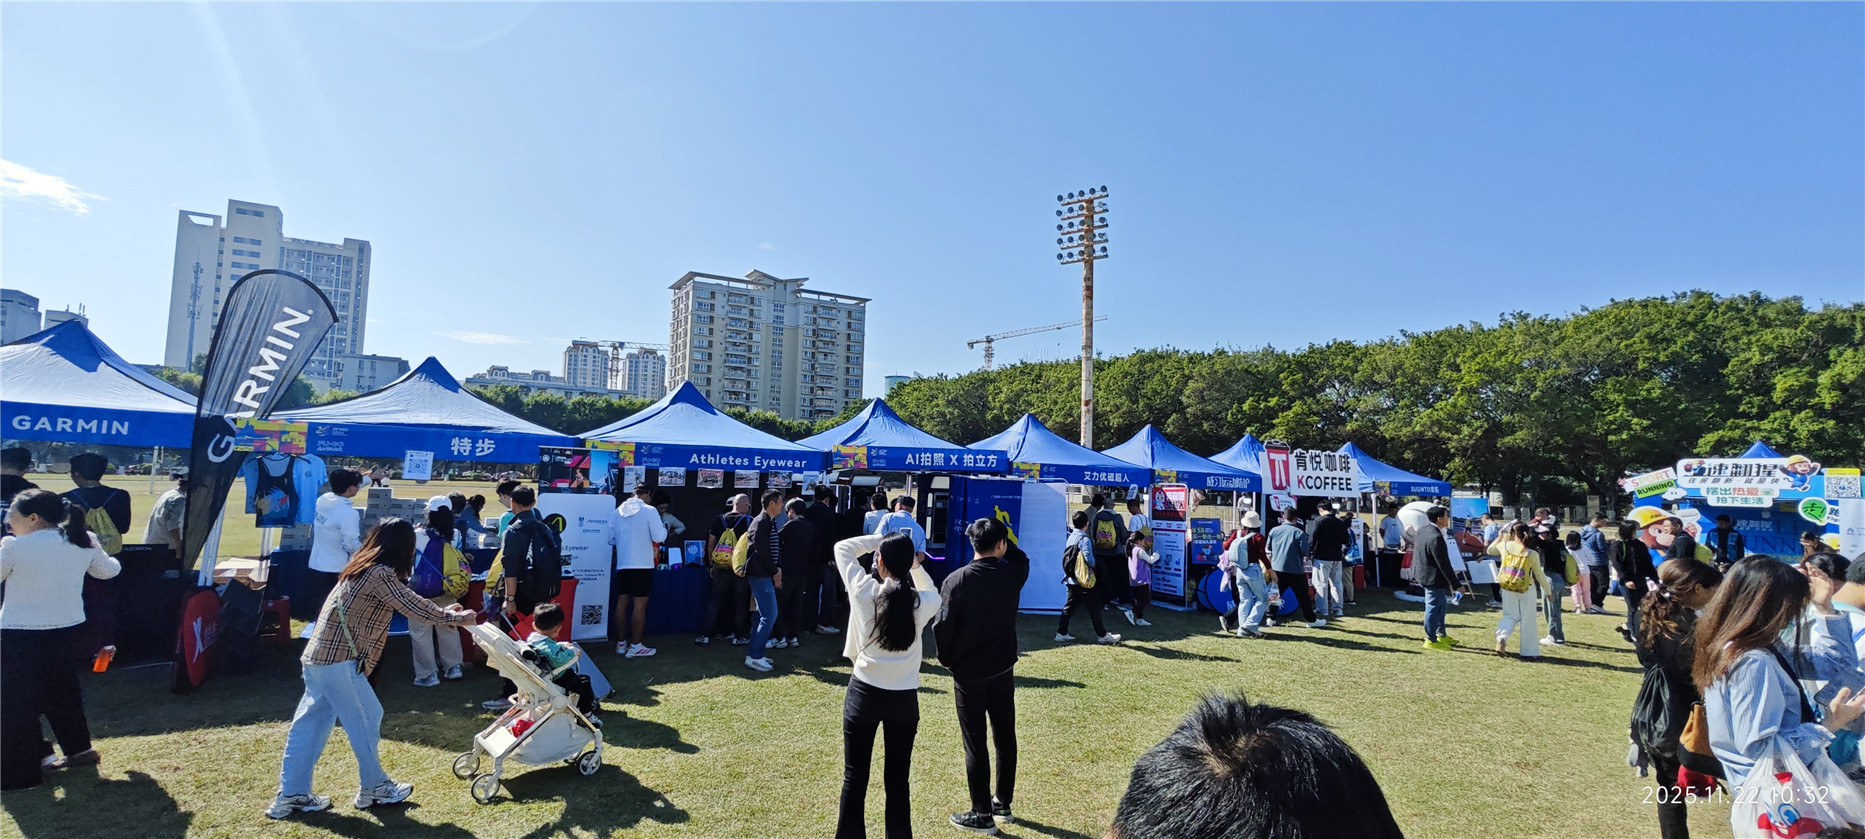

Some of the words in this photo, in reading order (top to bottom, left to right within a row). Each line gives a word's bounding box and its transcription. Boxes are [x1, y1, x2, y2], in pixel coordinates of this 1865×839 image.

[207, 306, 311, 463] GARMIN
[11, 414, 130, 436] GARMIN
[450, 437, 496, 457] 特步
[689, 453, 750, 466] Athletes
[754, 456, 808, 469] Eyewear
[905, 451, 945, 466] AI拍照
[949, 453, 959, 465] X
[962, 453, 998, 467] 拍立方
[1294, 451, 1352, 473] 肯悦咖啡
[1083, 470, 1130, 483] 艾力优磁超人
[1296, 474, 1353, 491] KCOFFEE
[1631, 470, 1672, 487] SPORT
[1636, 481, 1675, 495] RUNNING
[1716, 496, 1764, 505] 拍下生活
